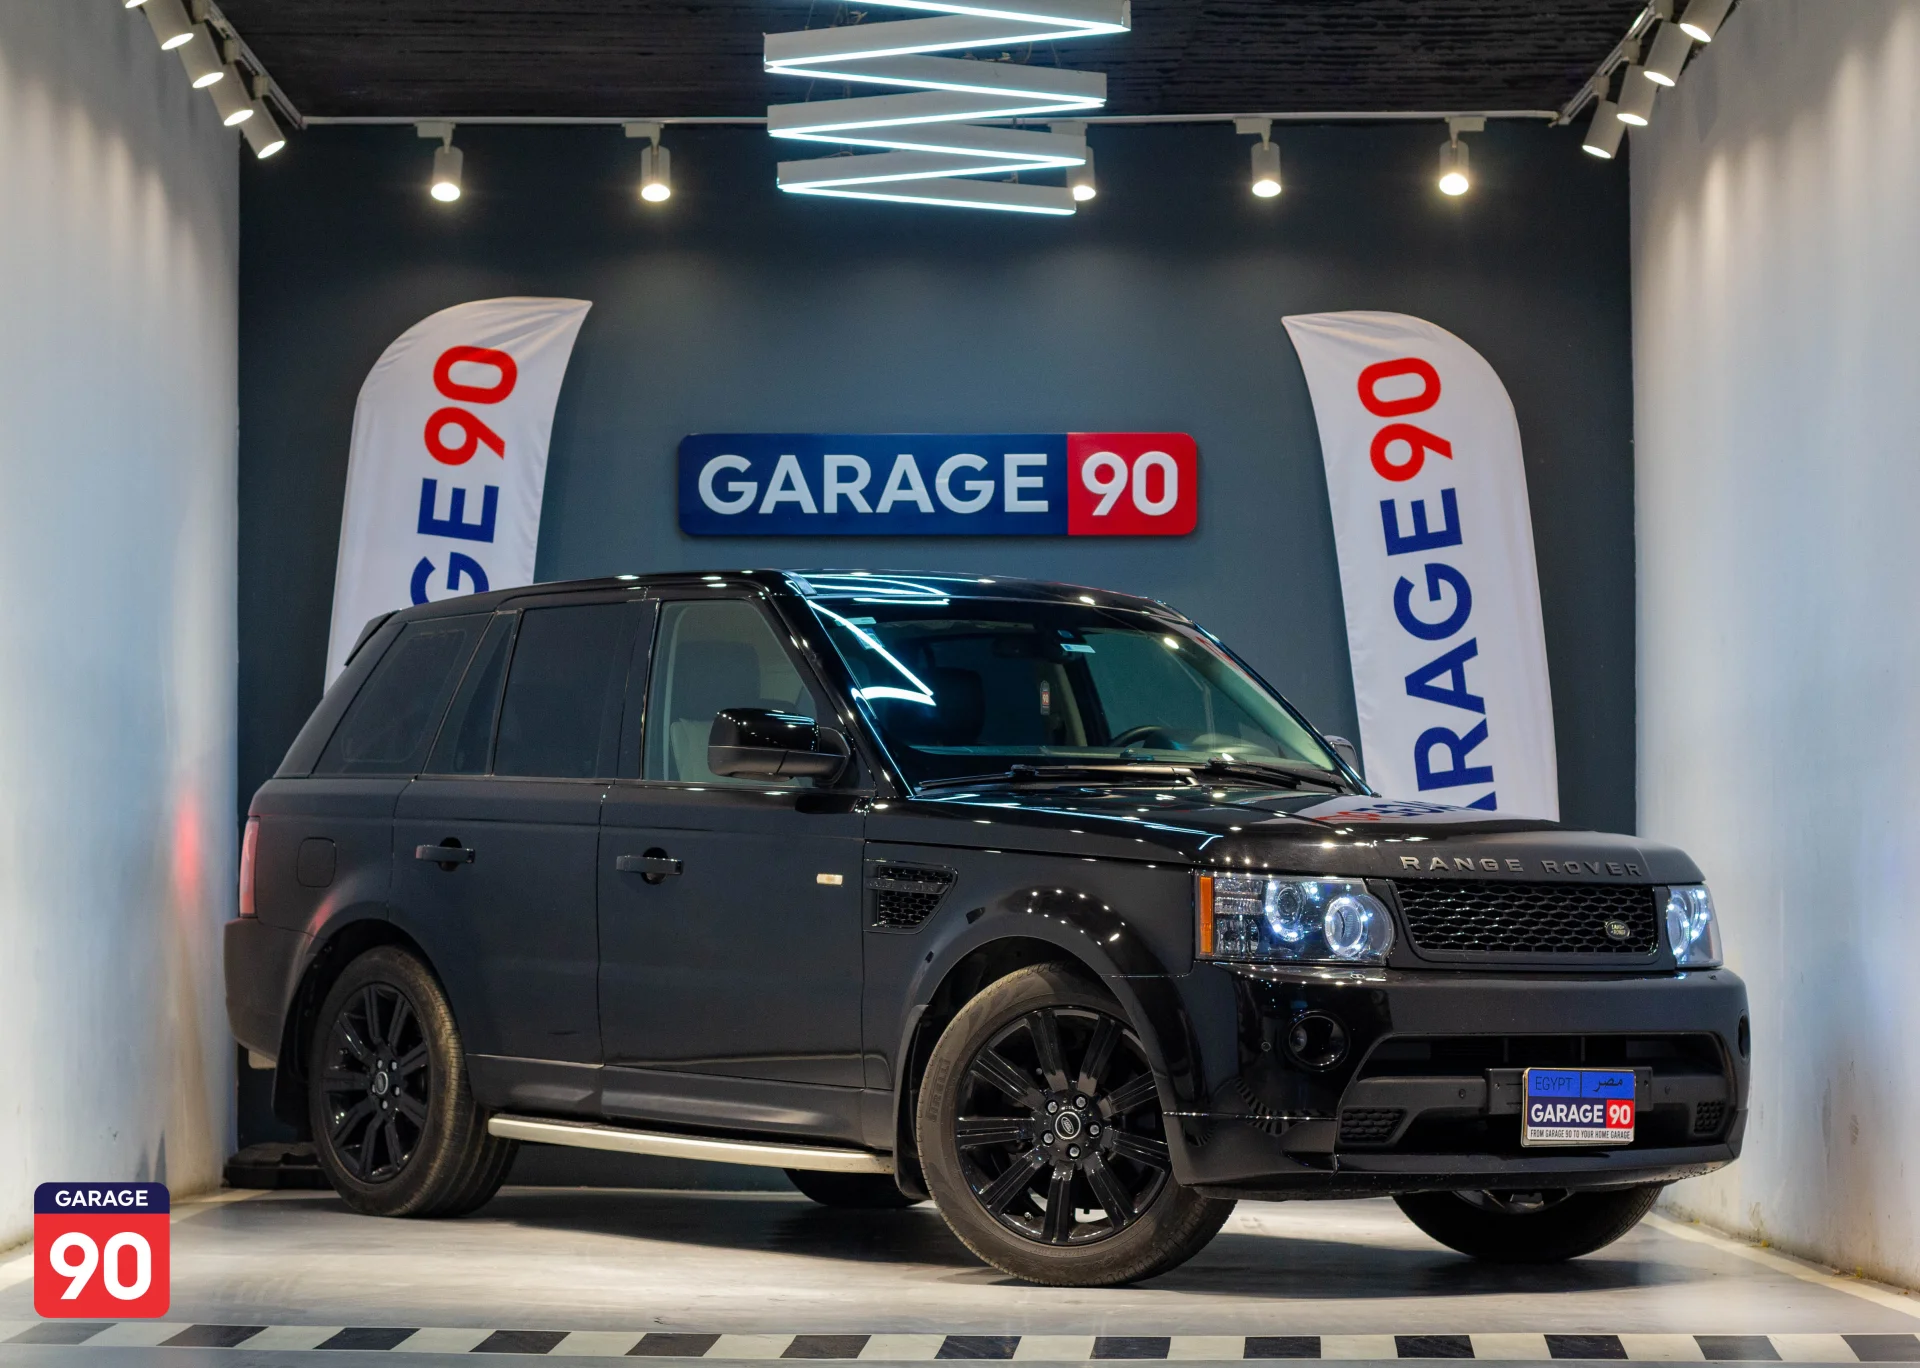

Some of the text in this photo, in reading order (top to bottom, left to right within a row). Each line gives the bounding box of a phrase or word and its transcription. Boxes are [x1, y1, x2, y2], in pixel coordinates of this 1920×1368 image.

[697, 450, 1179, 517] GARAGE 90
[1378, 487, 1498, 812] RAGE
[1400, 856, 1642, 876] RANGE ROVER
[1535, 1076, 1573, 1091] EGYPT
[1593, 1077, 1623, 1092] مصر
[1531, 1104, 1631, 1125] GARAGE 90
[1530, 1129, 1630, 1140] FROM GARAGE 90 TO YOUR HOME GARAGE
